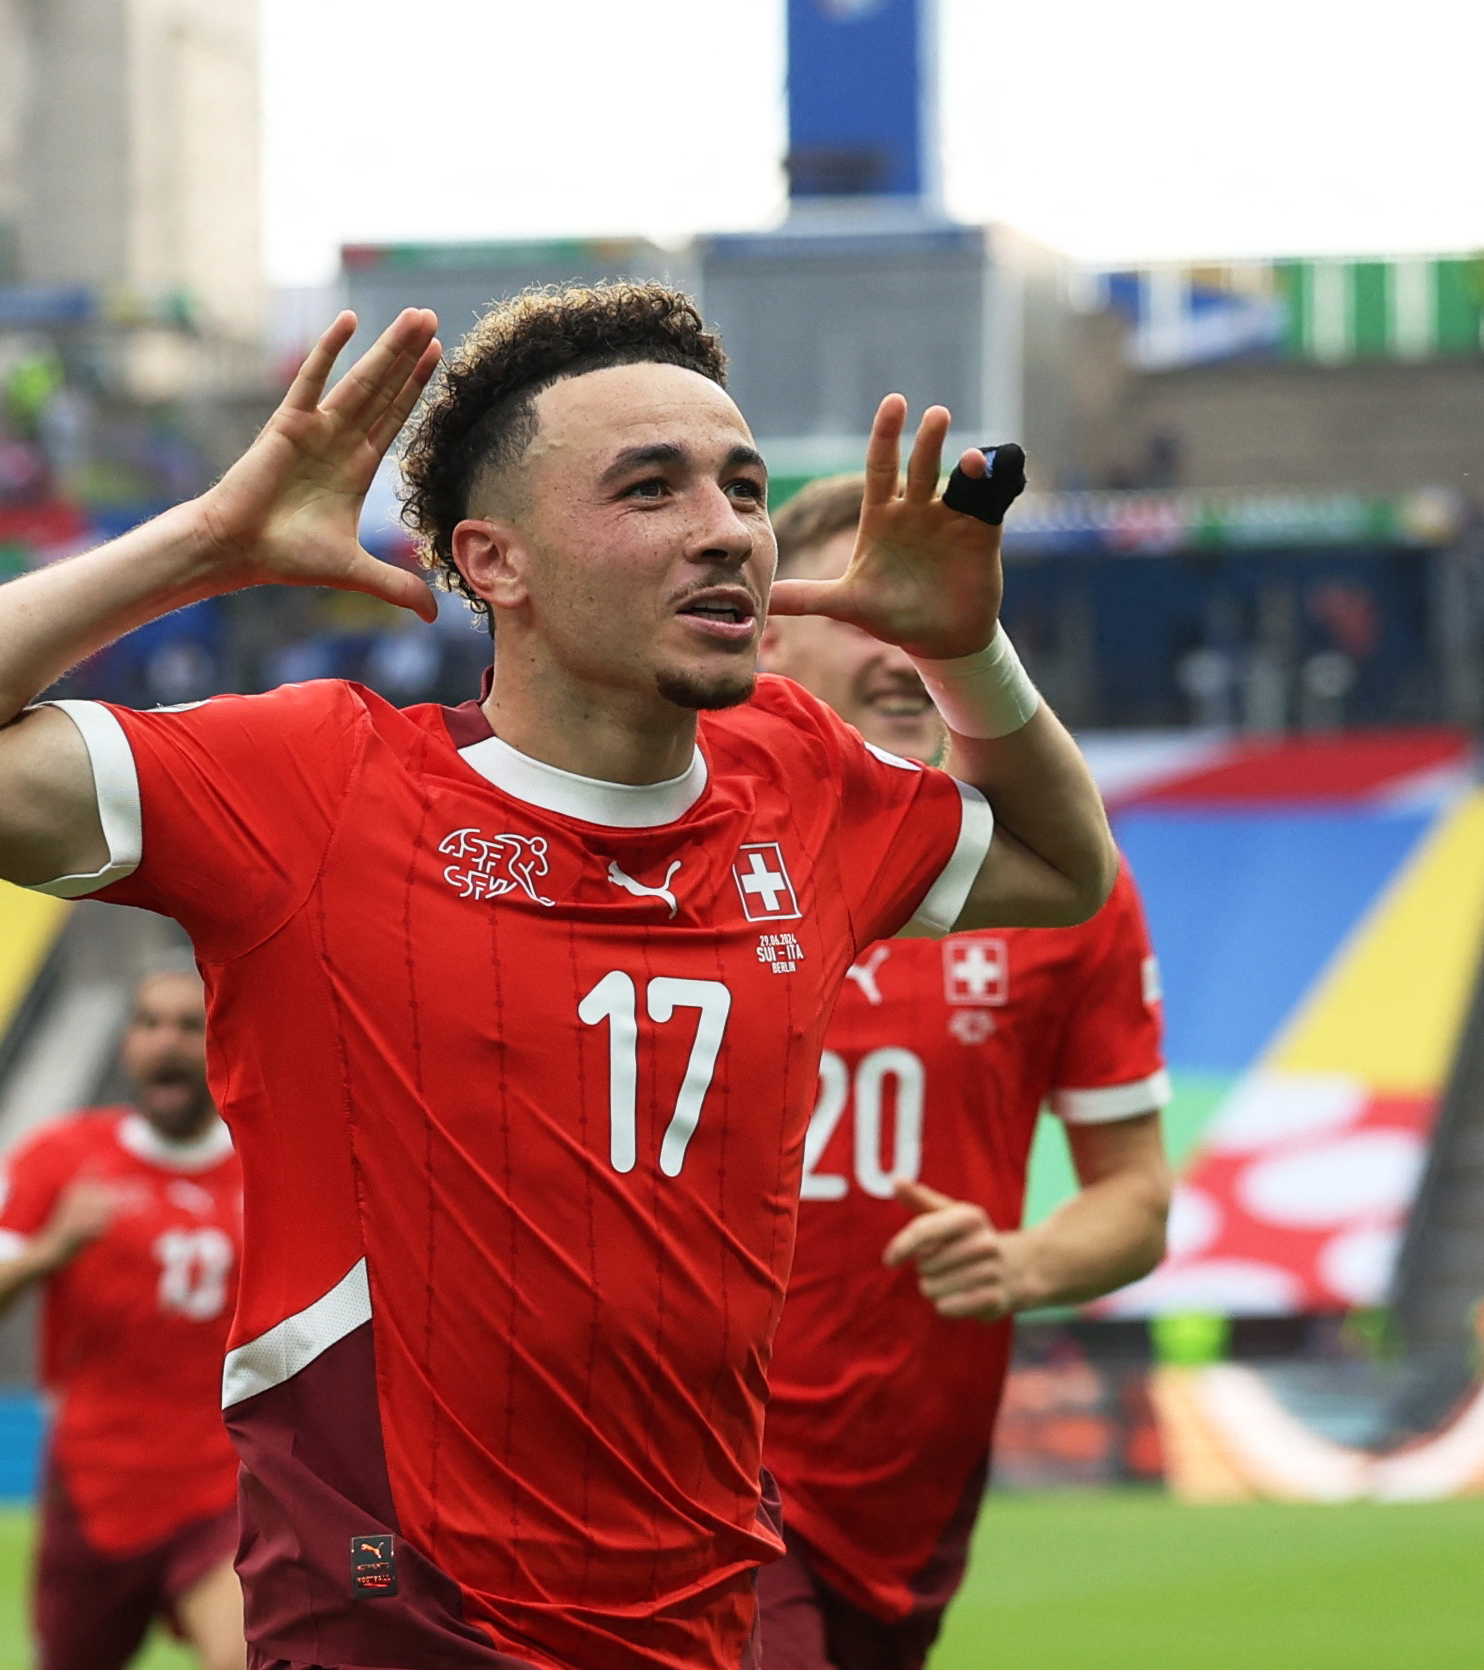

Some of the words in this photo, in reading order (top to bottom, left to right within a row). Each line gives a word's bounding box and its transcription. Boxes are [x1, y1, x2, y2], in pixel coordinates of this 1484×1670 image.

[756, 946, 777, 963] SUI
[786, 944, 804, 960] ITA
[771, 961, 796, 974] BERLIN
[577, 970, 731, 1177] 17
[800, 1048, 926, 1200] 20
